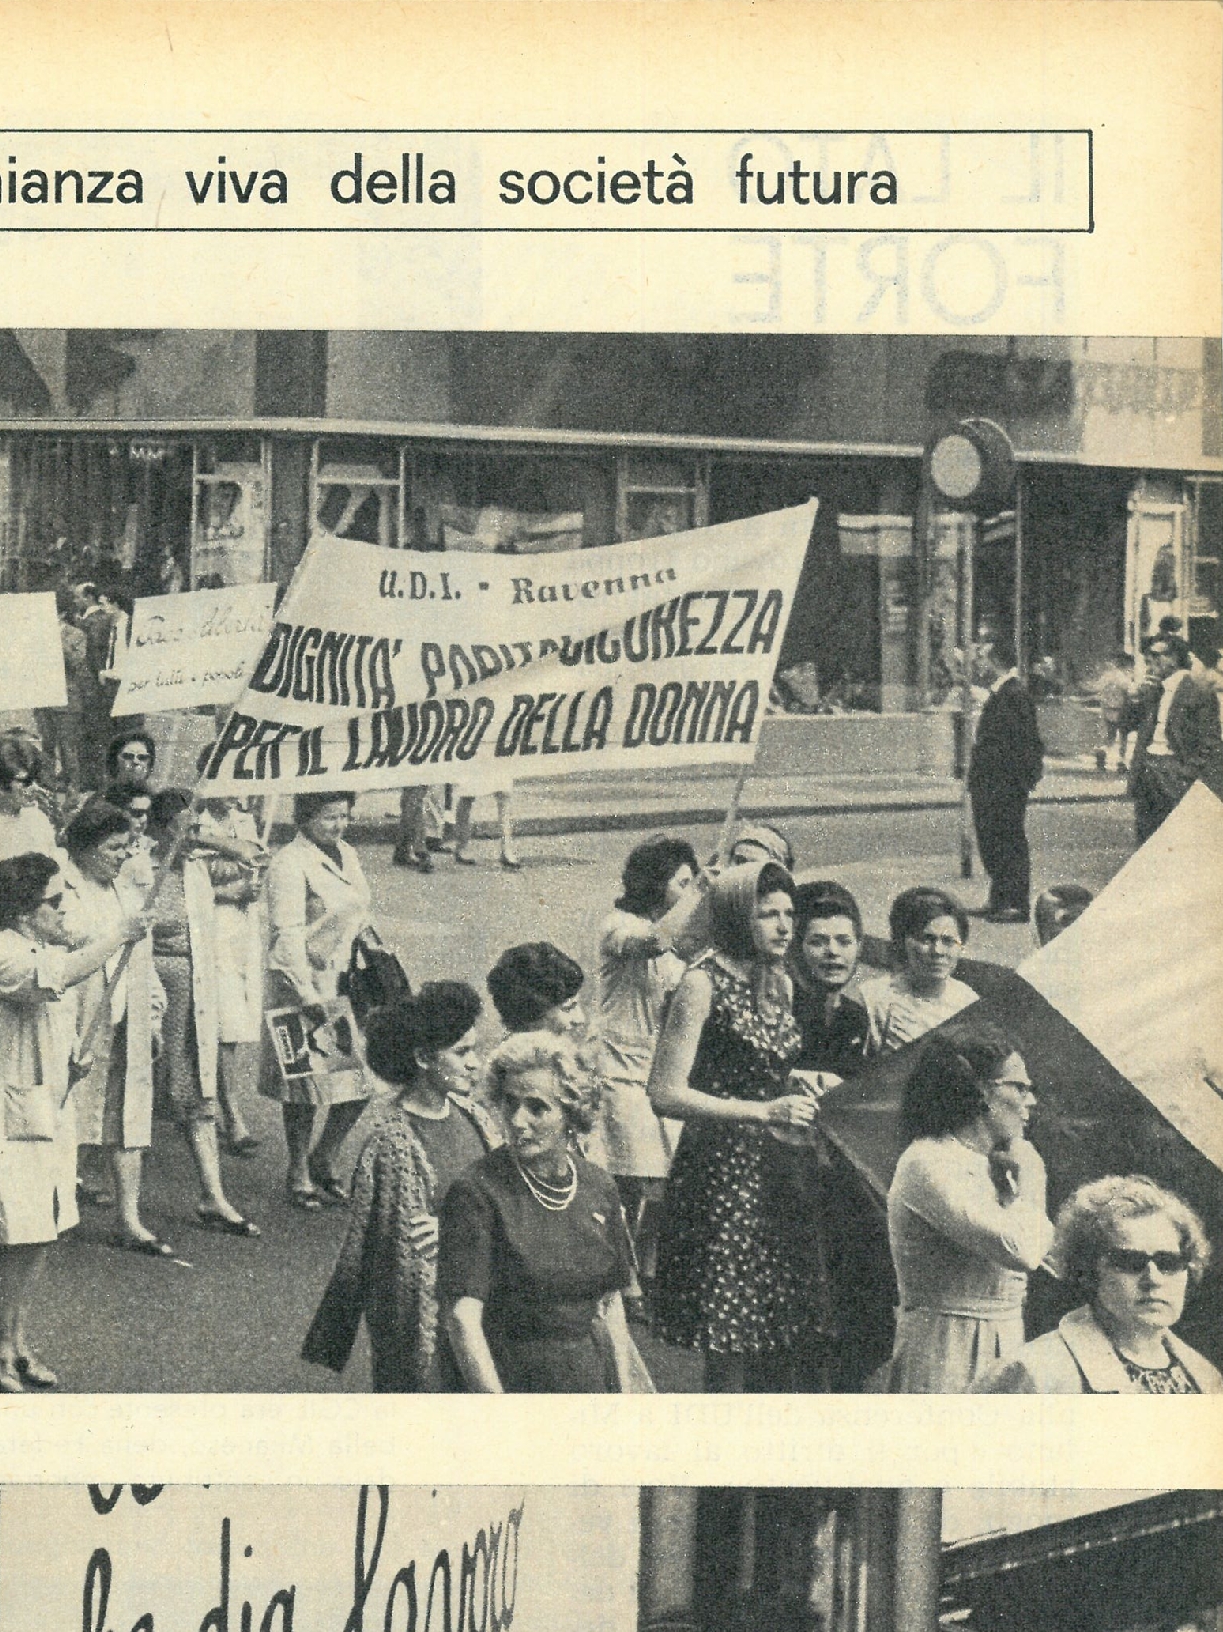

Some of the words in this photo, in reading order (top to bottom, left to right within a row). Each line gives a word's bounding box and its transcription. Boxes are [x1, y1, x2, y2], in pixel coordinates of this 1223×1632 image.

[185, 156, 288, 204] viva
[331, 152, 456, 205] della
[499, 153, 693, 205] società
[736, 153, 897, 205] futura
[379, 568, 462, 601] U.D.I.
[510, 567, 677, 605] Ravenna
[248, 621, 403, 709] DIGNITA'
[203, 711, 302, 780] PER
[296, 725, 328, 777] IL
[342, 696, 496, 772] LAVORO
[494, 685, 614, 758] DELLA
[622, 679, 760, 749] DONNA
